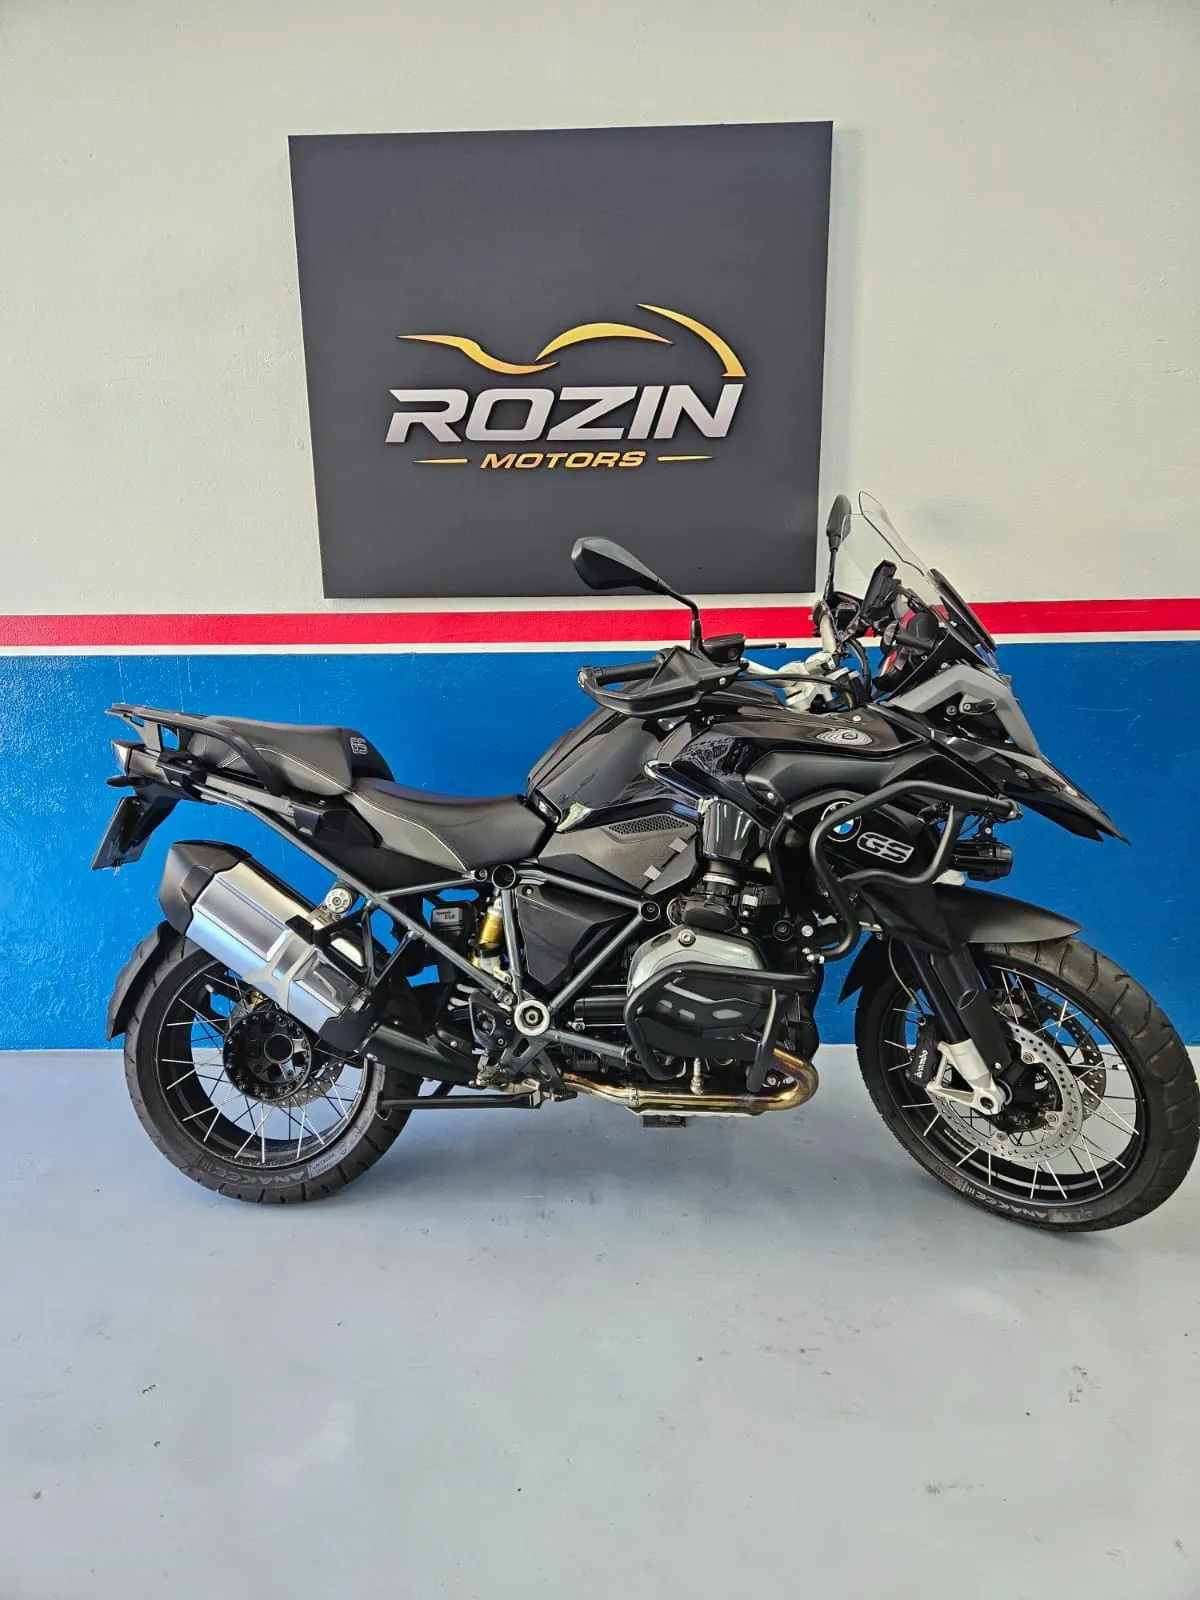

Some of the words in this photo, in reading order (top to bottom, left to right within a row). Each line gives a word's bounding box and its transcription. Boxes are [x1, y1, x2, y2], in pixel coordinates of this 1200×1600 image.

[385, 384, 744, 443] ROZIN
[480, 451, 648, 469] MOTORS
[857, 831, 915, 864] GS
